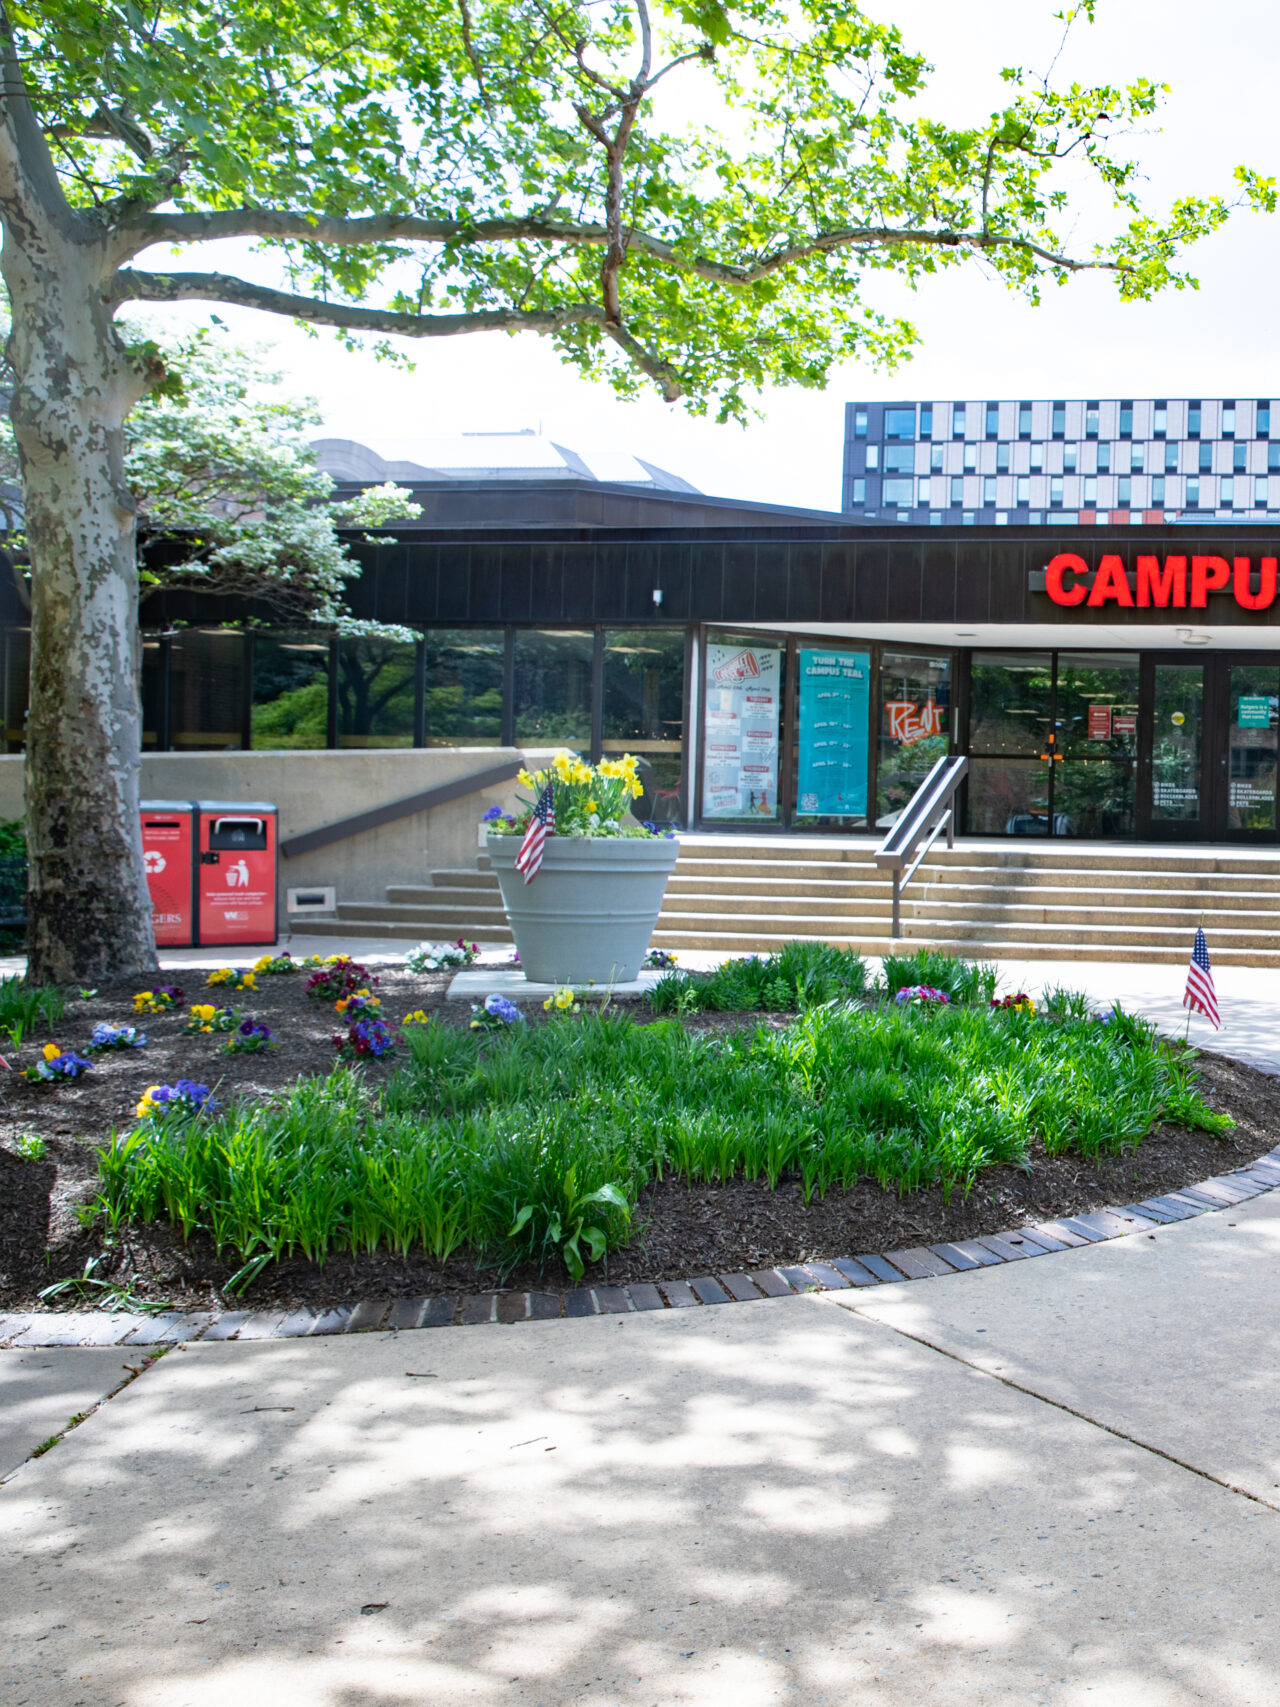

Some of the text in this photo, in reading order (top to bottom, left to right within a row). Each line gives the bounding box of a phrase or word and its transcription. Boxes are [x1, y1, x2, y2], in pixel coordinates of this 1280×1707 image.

[812, 656, 855, 668] TURN THE
[806, 667, 864, 679] CAMPUS TEAL
[886, 700, 944, 744] RENT
[151, 913, 182, 924] GERS
